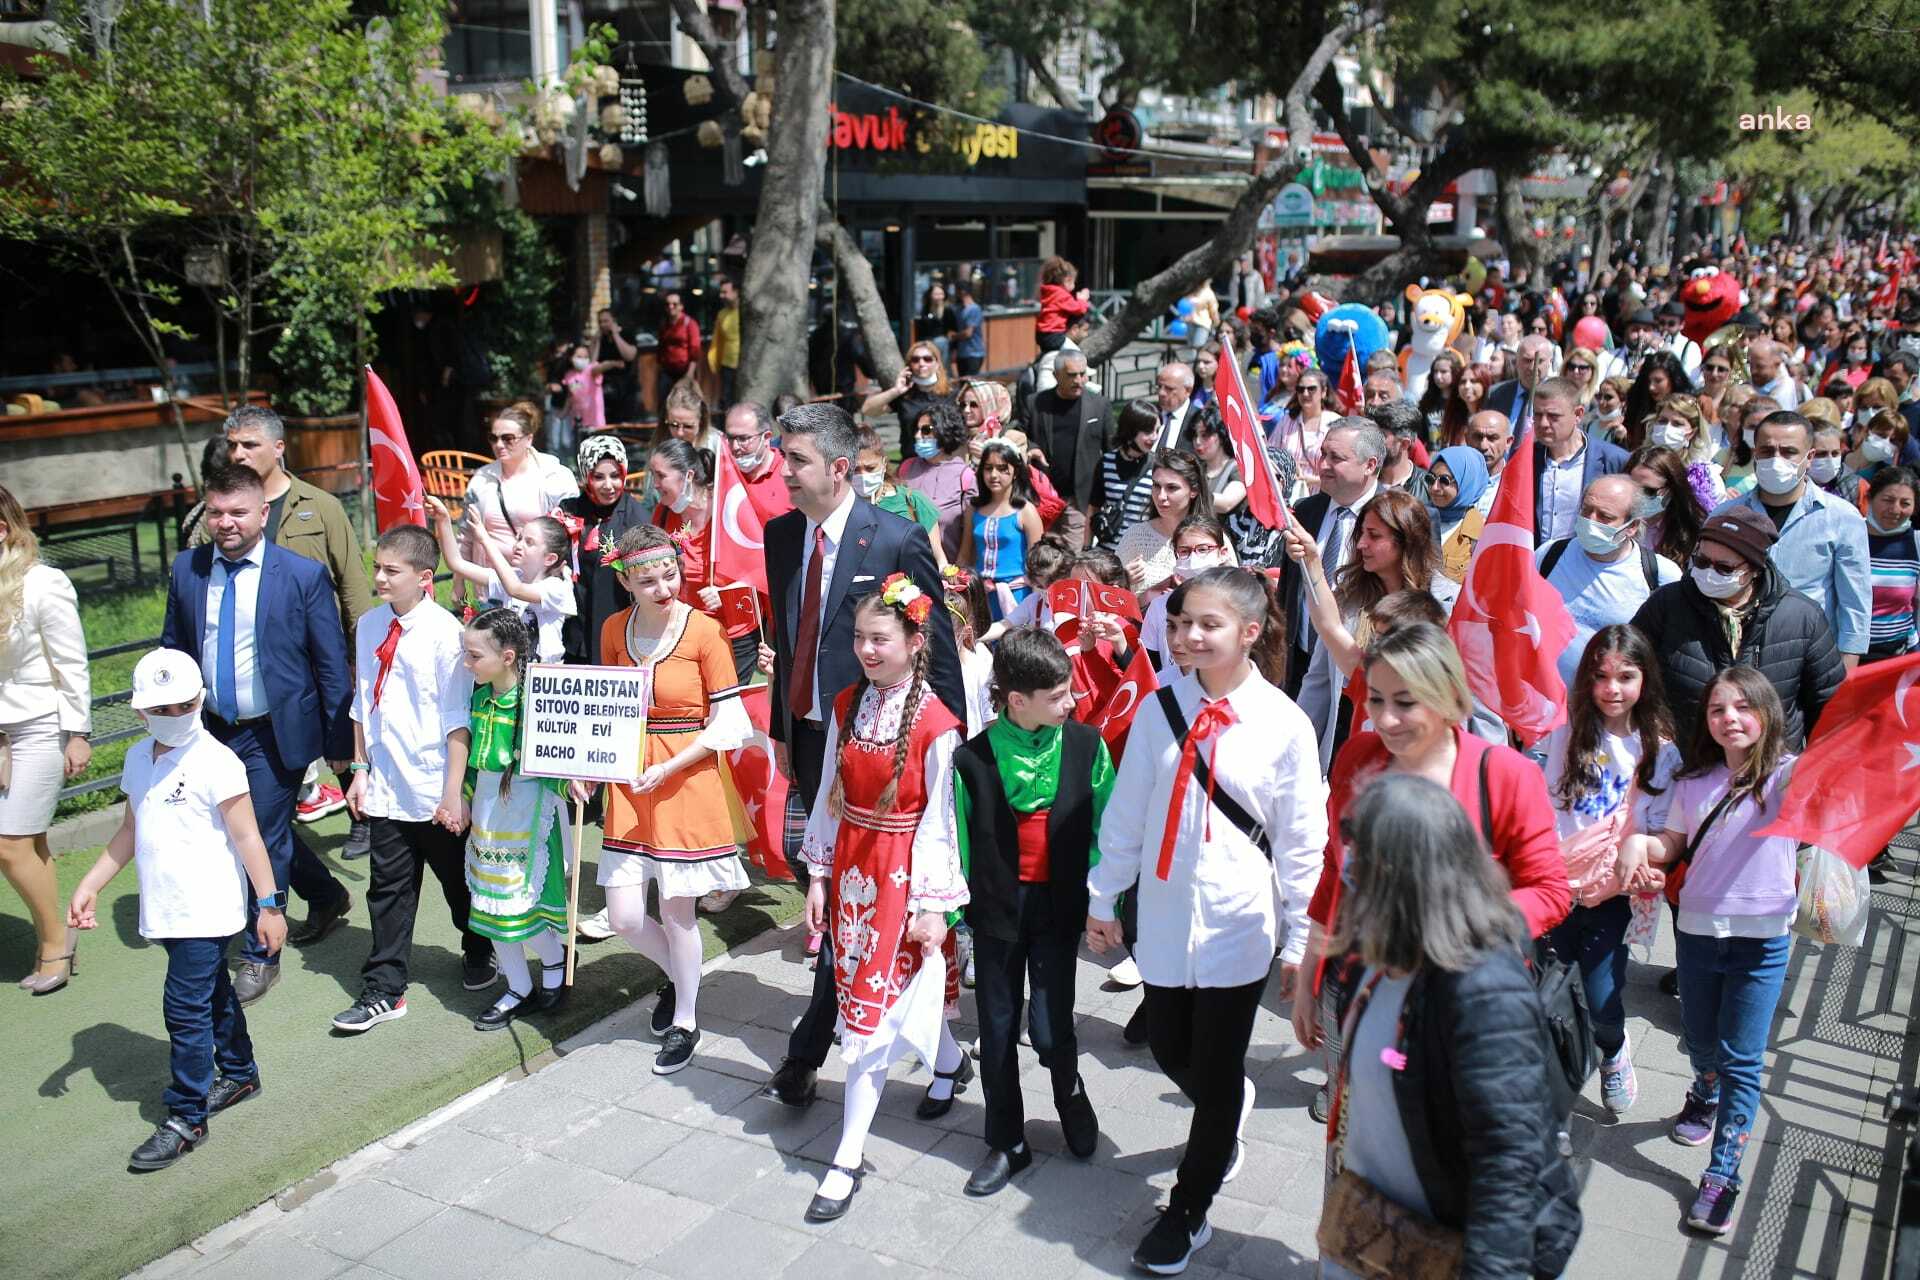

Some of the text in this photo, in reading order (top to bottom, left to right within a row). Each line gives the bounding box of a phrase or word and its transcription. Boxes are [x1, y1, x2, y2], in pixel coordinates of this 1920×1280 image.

[532, 676, 639, 698] BULGARISTAN
[584, 703, 640, 718] BELEDİYESİ
[537, 719, 612, 737] KÜLTÜR EVİ
[535, 744, 617, 764] BACHO KİRO
